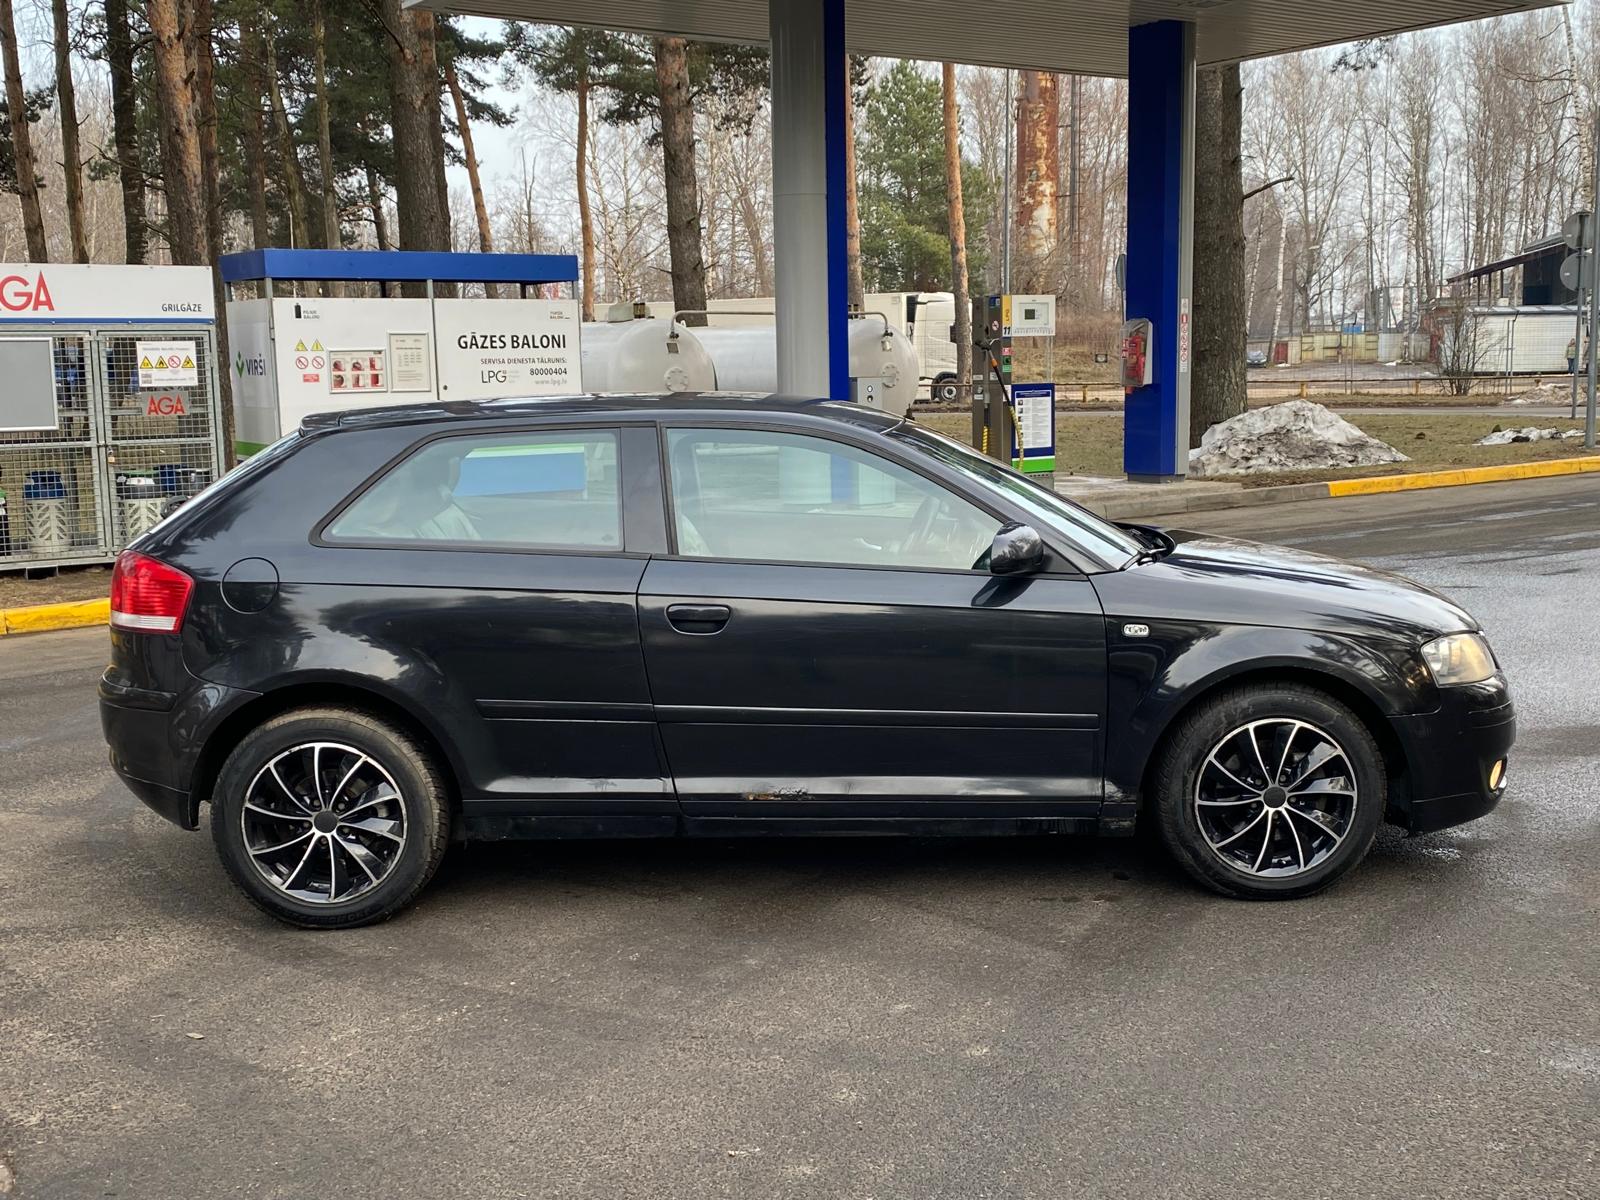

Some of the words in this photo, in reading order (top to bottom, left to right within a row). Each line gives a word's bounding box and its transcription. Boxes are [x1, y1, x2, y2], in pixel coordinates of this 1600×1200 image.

[0, 270, 55, 311] GA
[1003, 326, 1011, 335] 11
[457, 332, 507, 349] GĀZES
[511, 334, 566, 349] BALONI
[245, 353, 266, 376] VIRŠI
[481, 370, 507, 384] LPG
[147, 394, 185, 415] AGA
